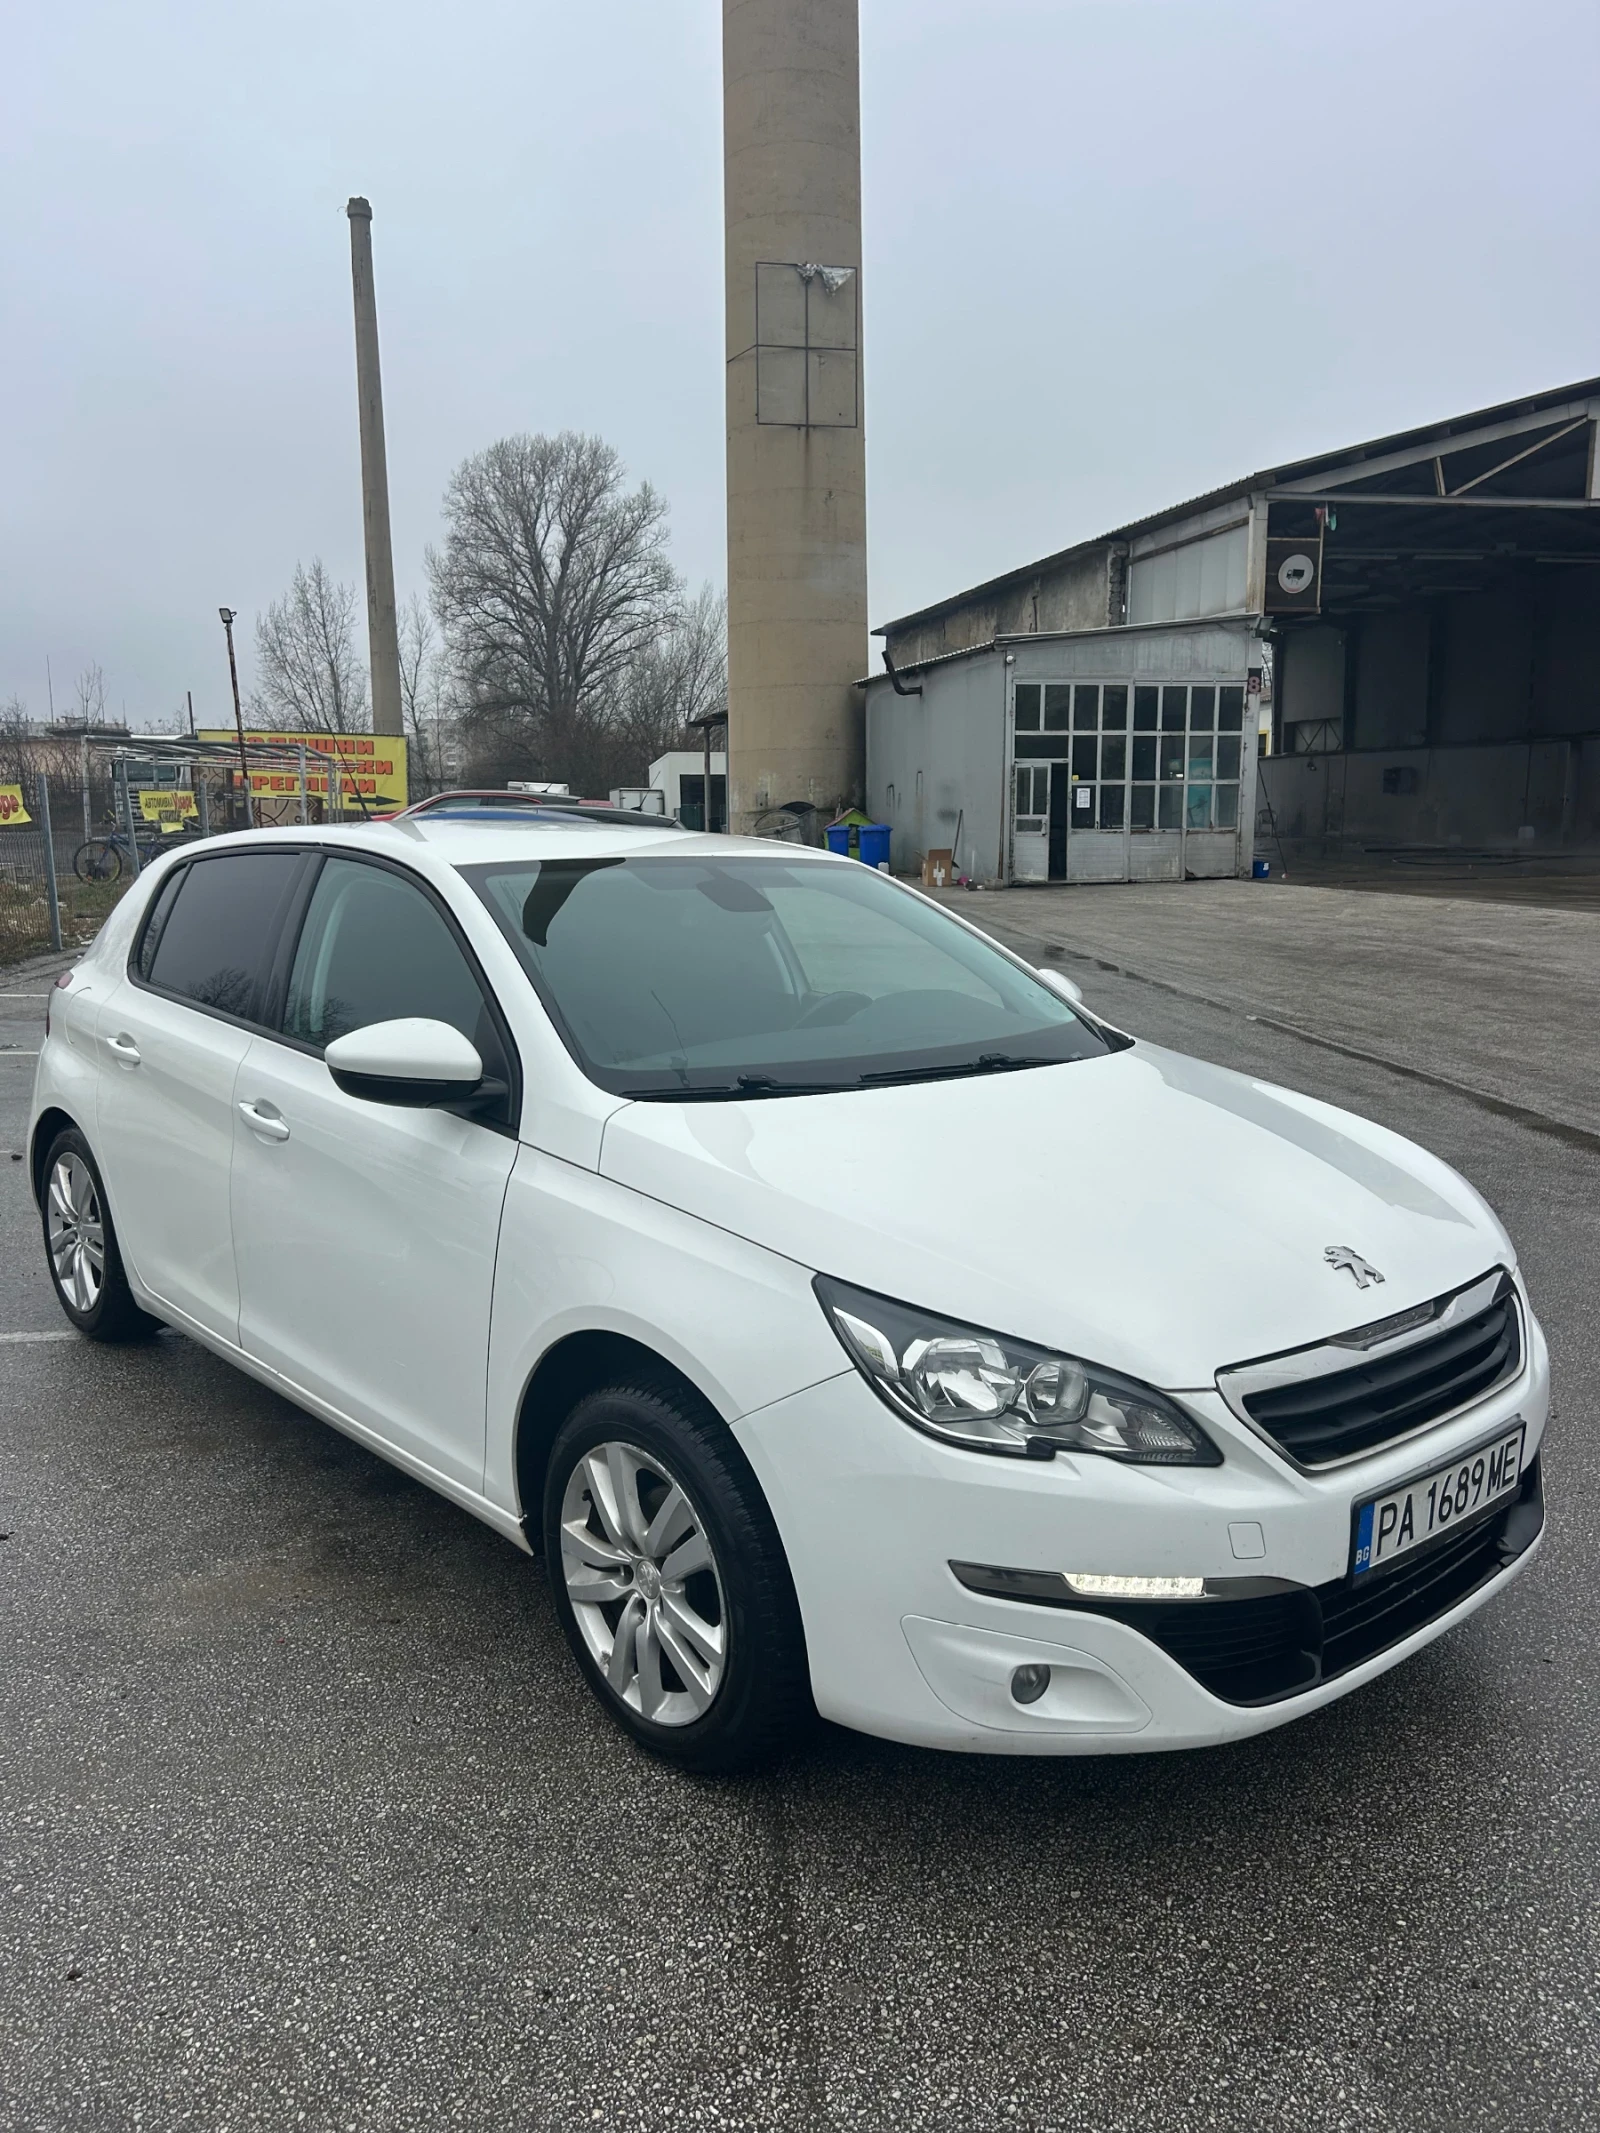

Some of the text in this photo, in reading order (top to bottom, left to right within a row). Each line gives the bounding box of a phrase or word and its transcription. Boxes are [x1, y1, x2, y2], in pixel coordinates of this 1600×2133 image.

[1248, 676, 1260, 693] 8
[0, 794, 20, 820] ge
[1376, 1437, 1518, 1557] PA 1689 ME
[1355, 1546, 1370, 1565] BG
